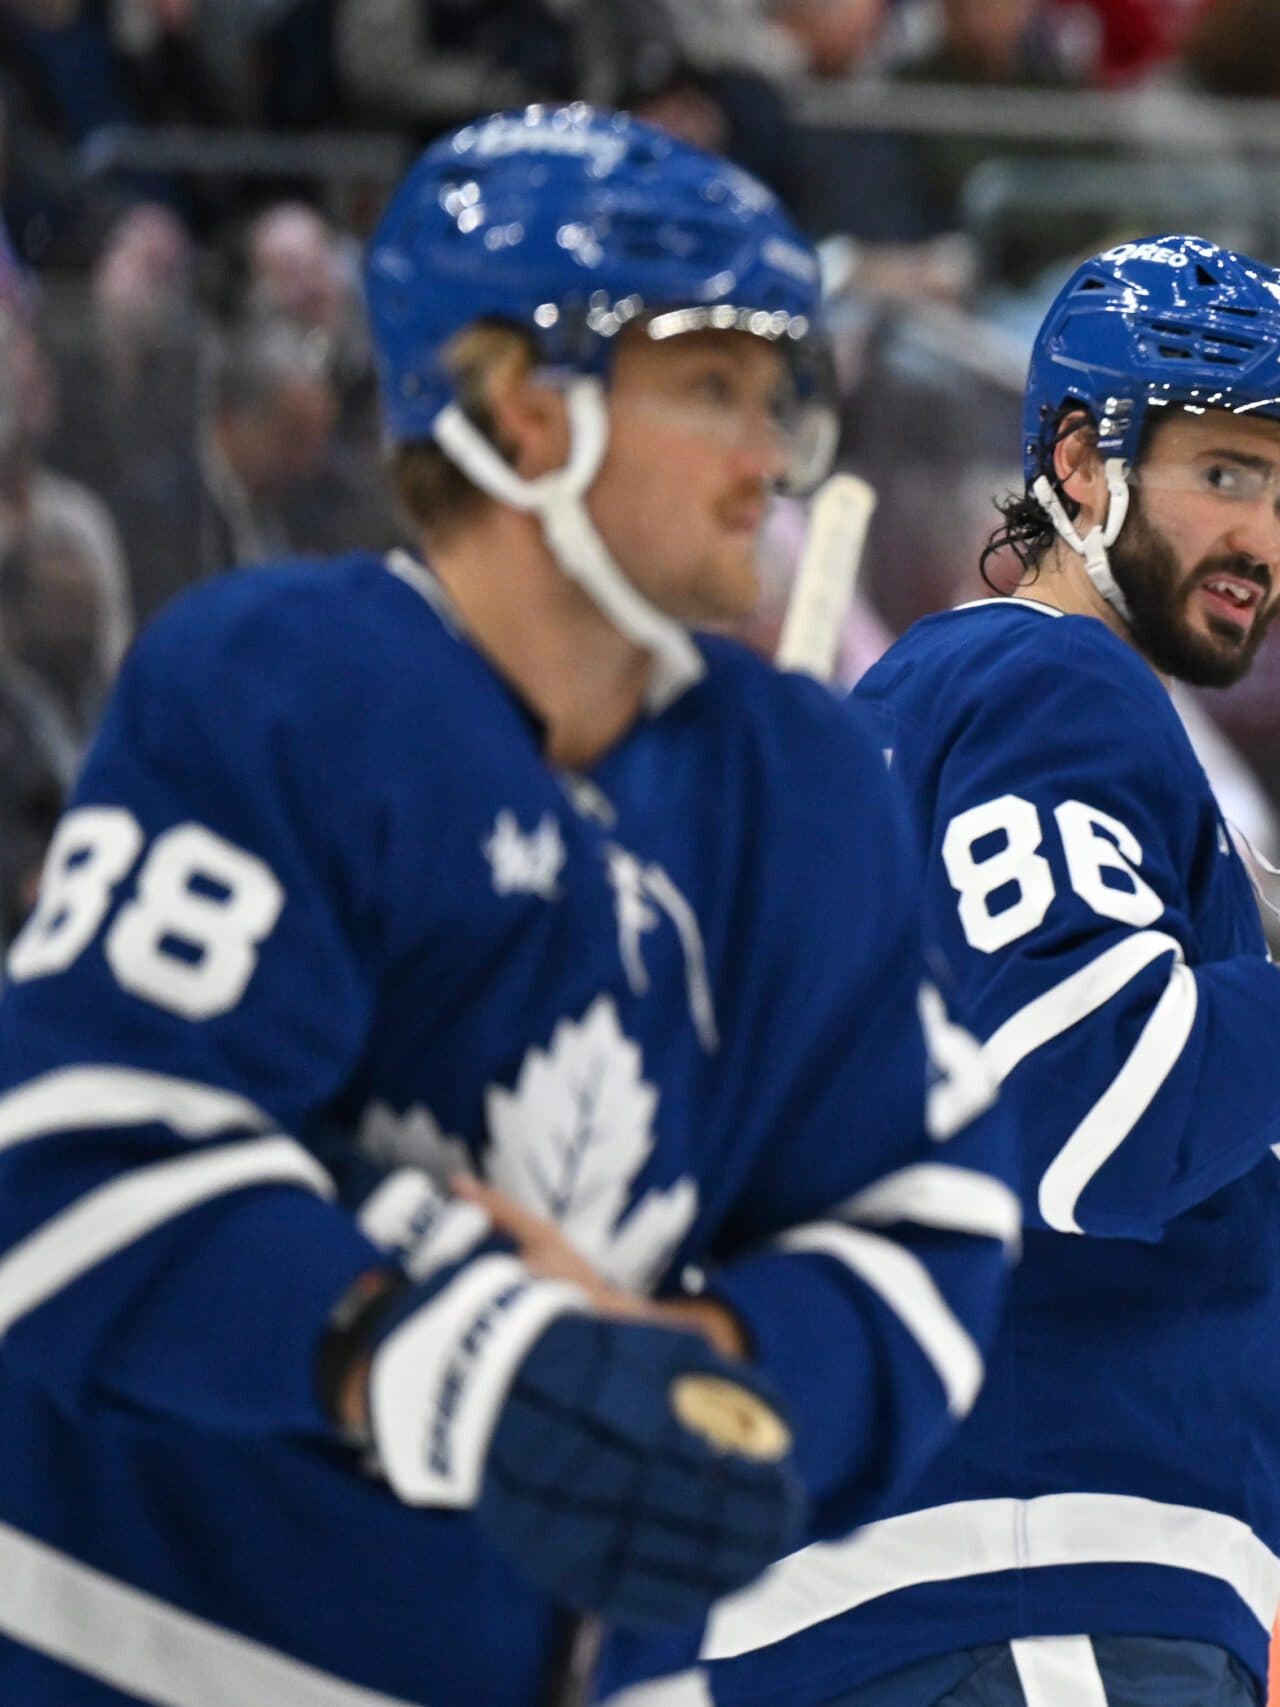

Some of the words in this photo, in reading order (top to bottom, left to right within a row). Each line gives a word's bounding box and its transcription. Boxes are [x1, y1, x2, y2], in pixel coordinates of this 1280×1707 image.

[1101, 244, 1188, 266] OREO
[7, 806, 285, 1021] 88
[942, 795, 1164, 953] 86
